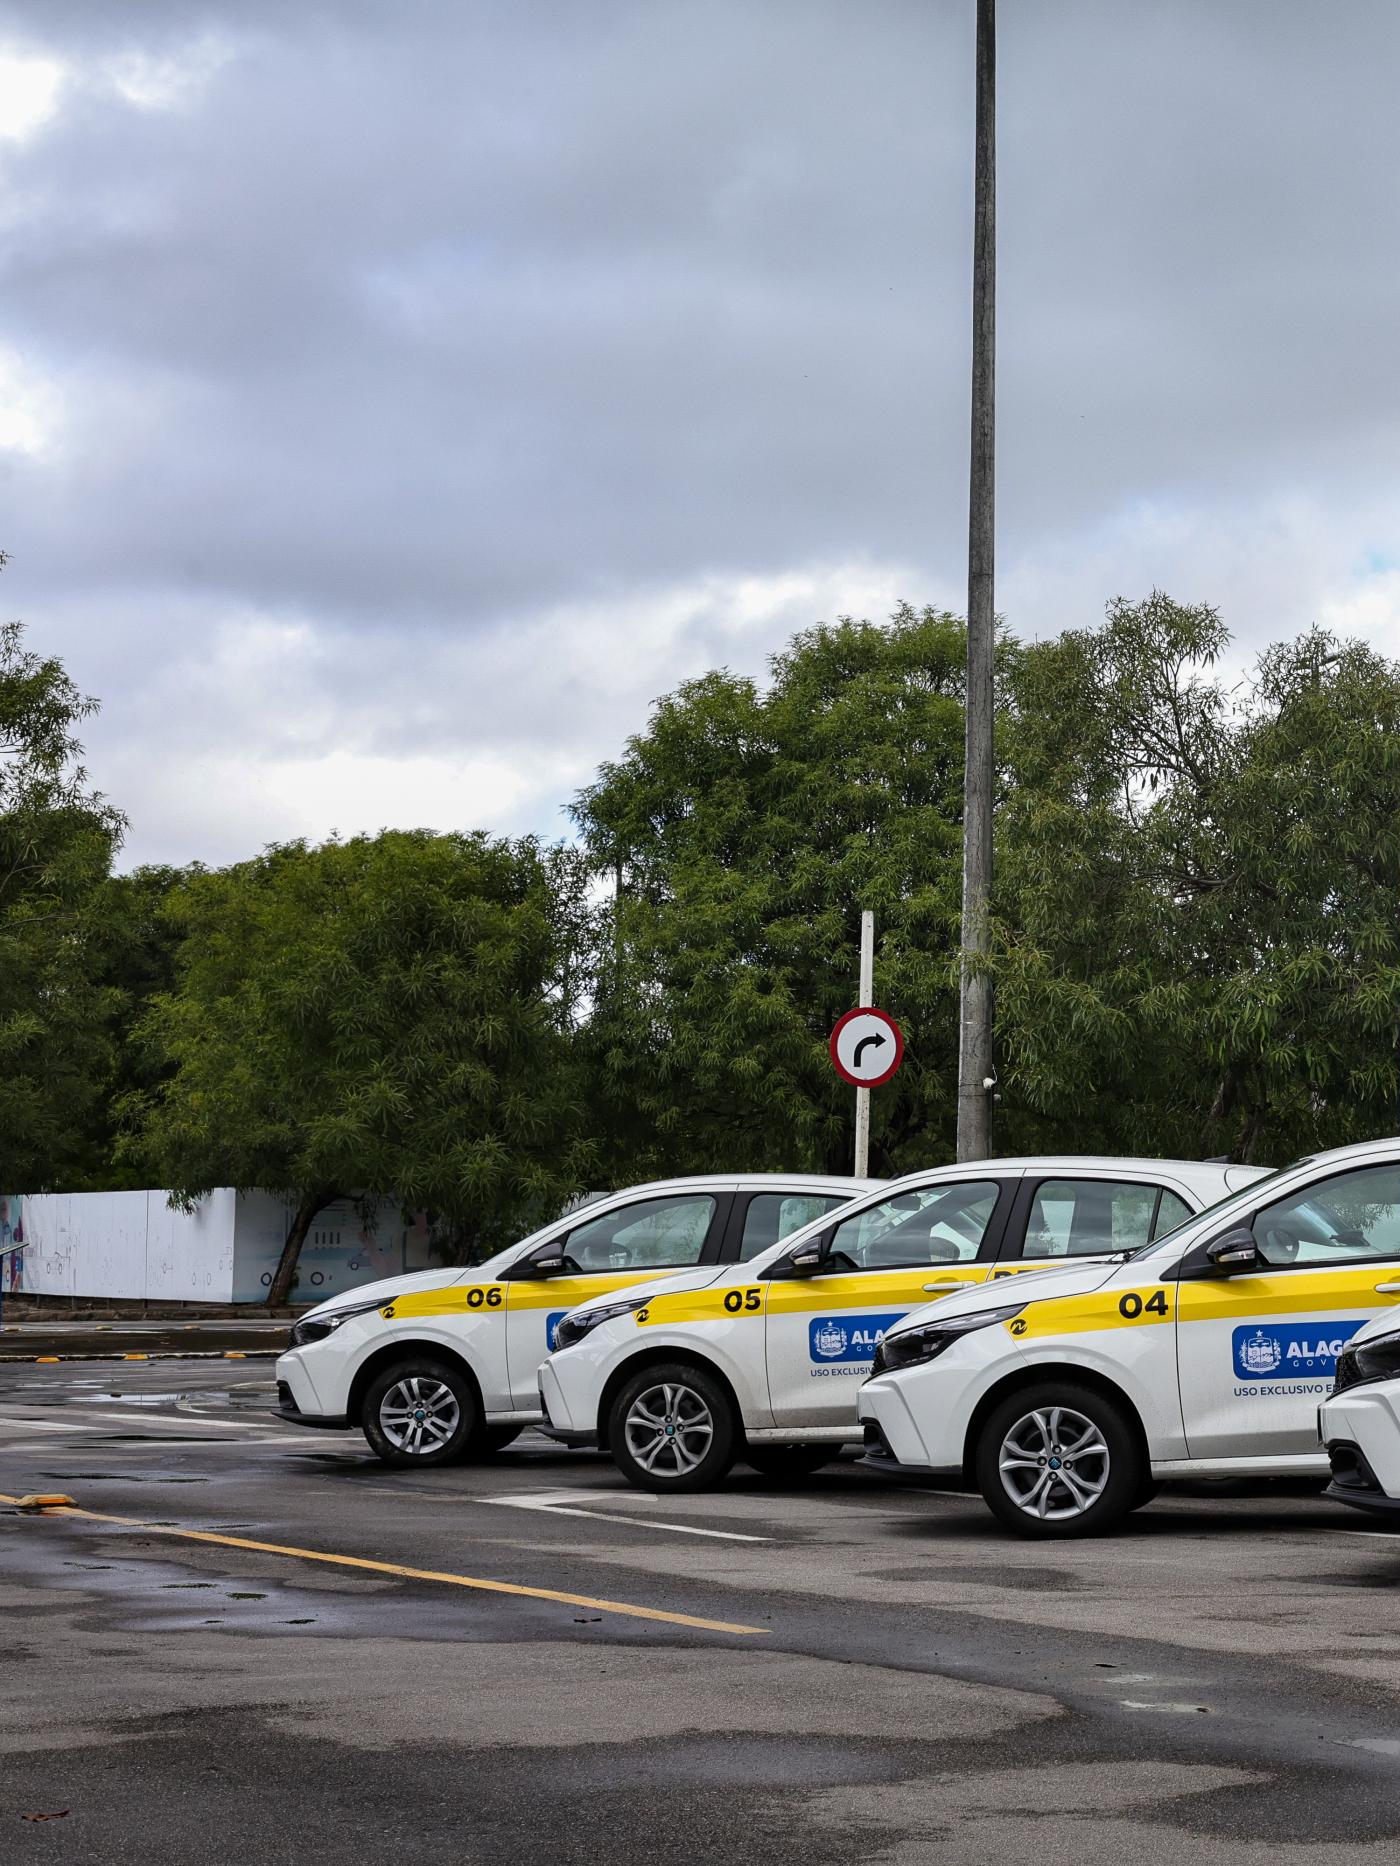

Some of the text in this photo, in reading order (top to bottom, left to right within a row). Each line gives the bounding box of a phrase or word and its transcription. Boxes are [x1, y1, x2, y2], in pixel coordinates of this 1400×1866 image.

[467, 1287, 502, 1308] 06
[724, 1288, 761, 1312] 05
[1119, 1290, 1168, 1319] 04
[810, 1368, 830, 1377] USO
[1233, 1387, 1258, 1397] USO
[1260, 1384, 1324, 1396] EXCLUSIVO
